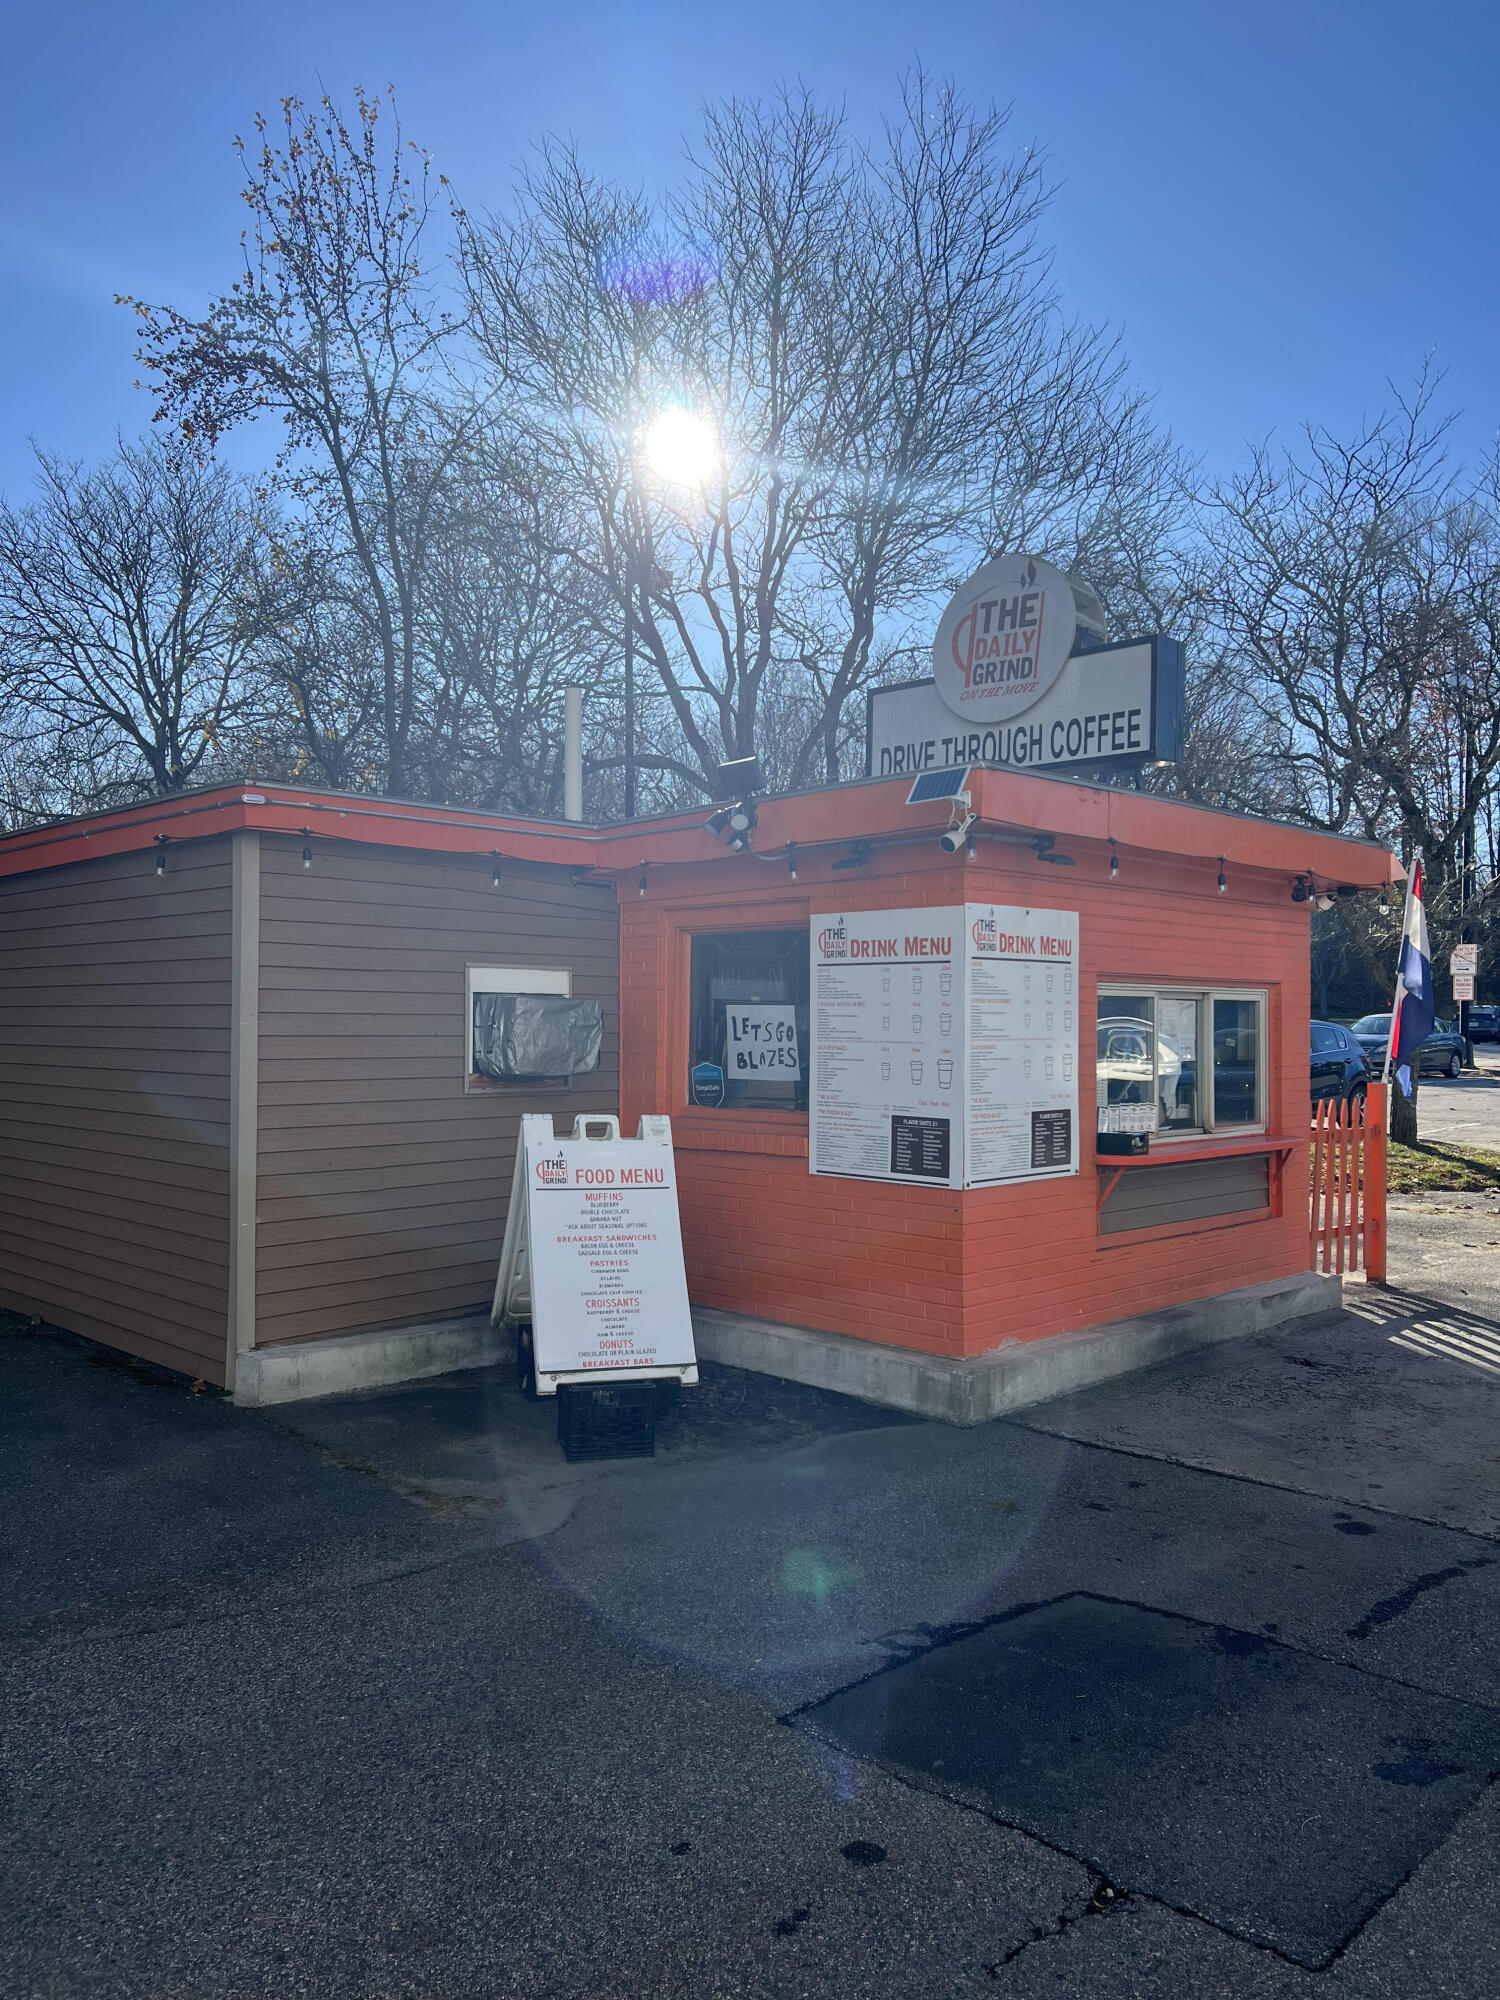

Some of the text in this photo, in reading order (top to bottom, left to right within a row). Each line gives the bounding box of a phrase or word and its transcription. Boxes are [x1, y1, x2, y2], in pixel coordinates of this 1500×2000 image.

[980, 592, 1039, 634] THE
[974, 629, 1036, 660] DAILY
[972, 656, 1033, 686] GRIND
[960, 682, 1039, 701] ON THE MOVE
[880, 708, 1142, 776] DRIVE THROUGH COFFEE
[979, 919, 996, 932] THE
[826, 928, 846, 940] THE
[979, 933, 996, 942] DAILY
[826, 941, 846, 950] DAILY
[850, 936, 952, 958] DRINK MENU
[979, 942, 997, 951] GRIND
[999, 933, 1072, 957] DRINK MENU
[826, 950, 846, 958] GRIND
[776, 1021, 794, 1043] GO
[736, 1047, 797, 1070] BLAZES
[545, 1160, 565, 1169] THE
[575, 1168, 664, 1184] FOOD MENU
[585, 1192, 624, 1201] MUFFINS
[585, 1297, 640, 1308] CROISSANTS
[600, 1339, 634, 1350] DONUTS
[578, 1350, 609, 1358] CHOCOLATE
[582, 1357, 655, 1368] BREAKFAST BARS
